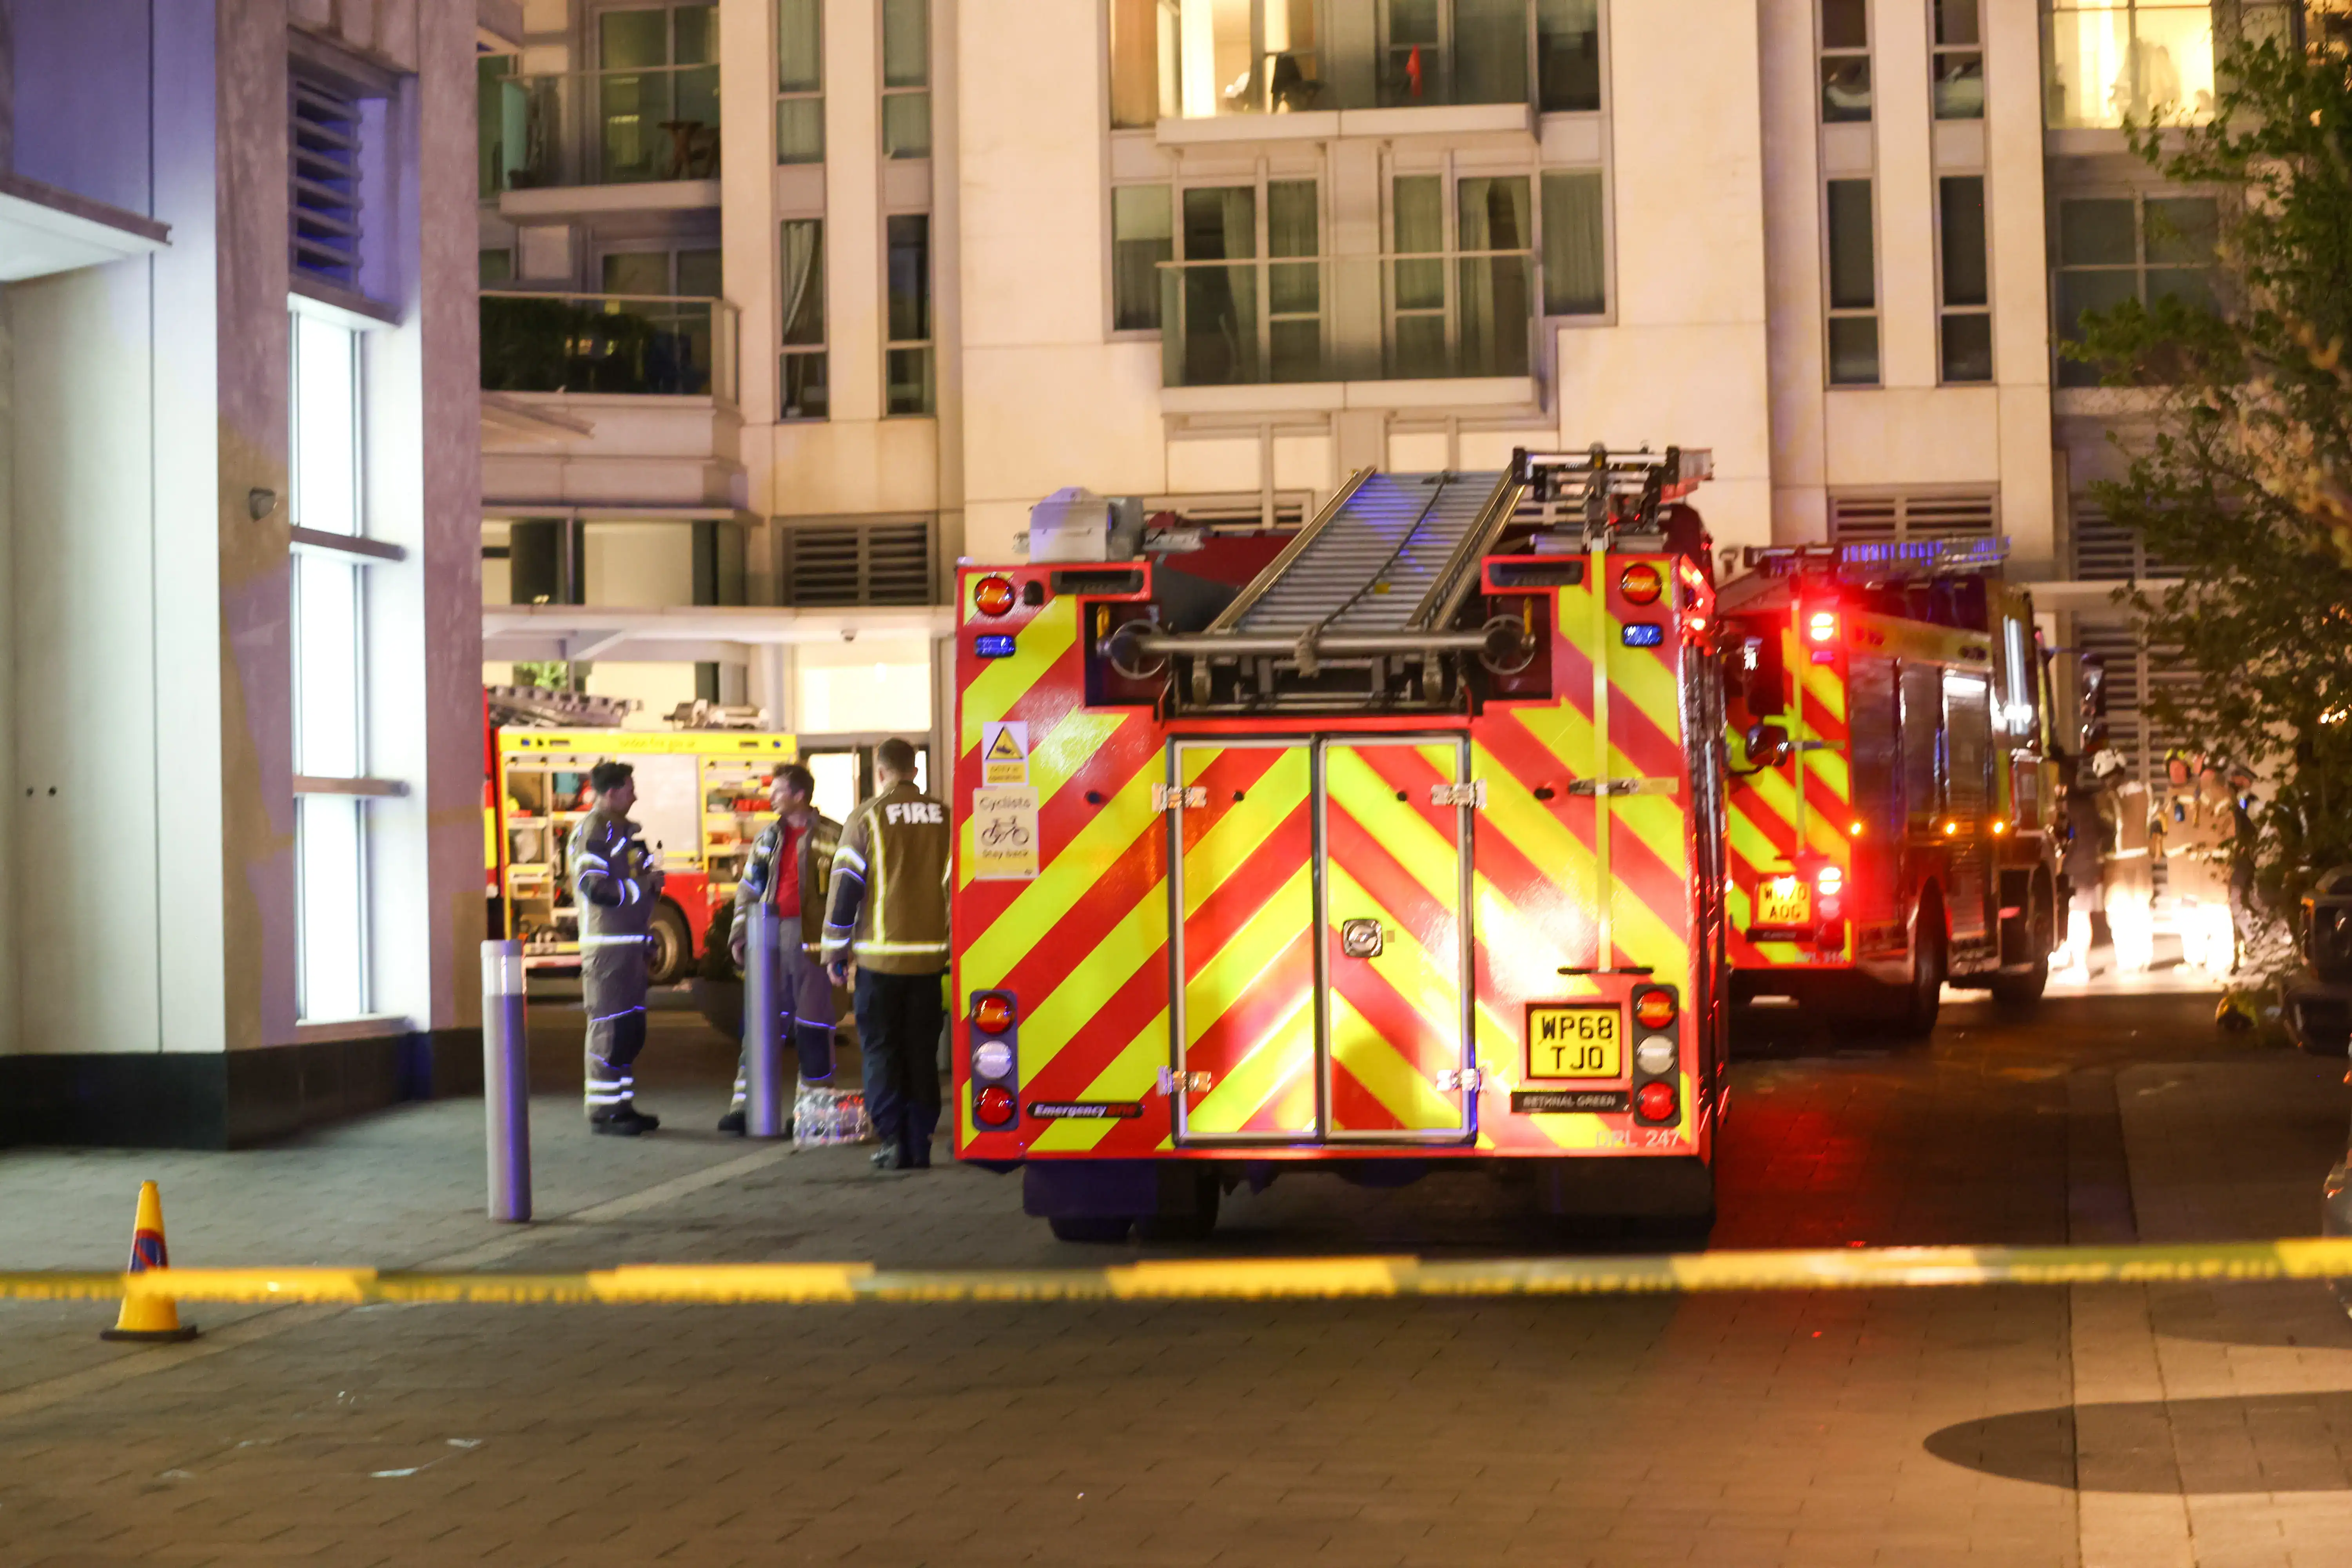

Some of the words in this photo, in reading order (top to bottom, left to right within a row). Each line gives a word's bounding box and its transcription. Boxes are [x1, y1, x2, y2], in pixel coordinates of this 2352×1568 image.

[979, 795, 1031, 813] Cyclists
[885, 802, 944, 825] FIRE
[1541, 1016, 1613, 1040] WP68
[1523, 1095, 1575, 1107] BETHNAL
[1576, 1094, 1616, 1107] GREEN
[1034, 1103, 1107, 1118] Emergency
[1596, 1129, 1638, 1147] DPL
[1645, 1129, 1681, 1148] 247
